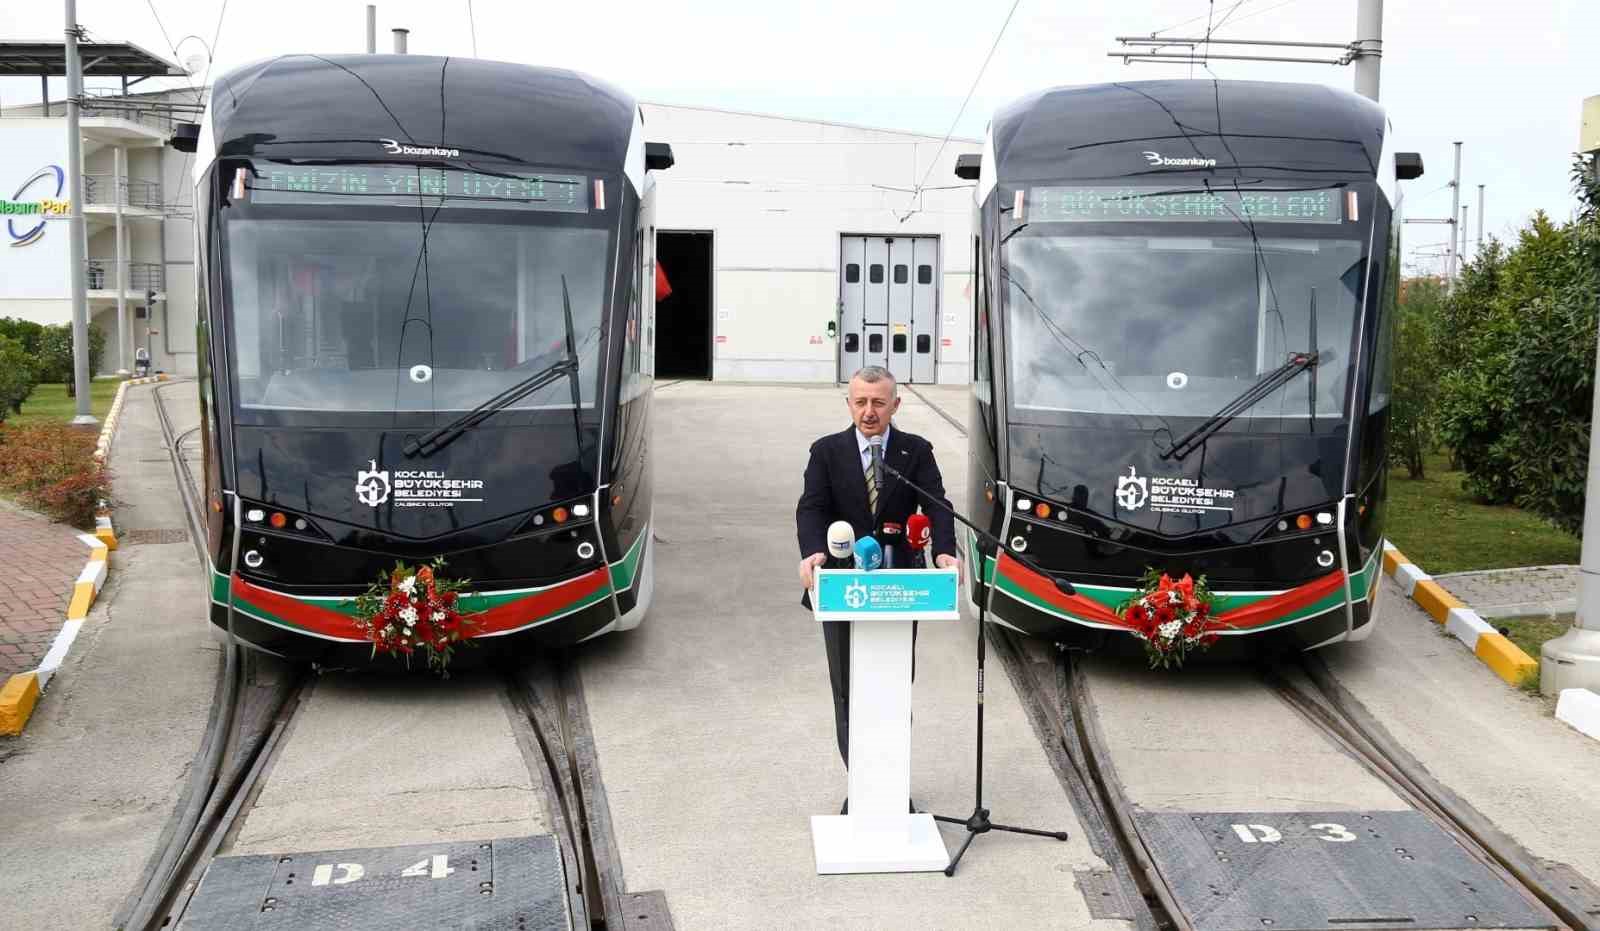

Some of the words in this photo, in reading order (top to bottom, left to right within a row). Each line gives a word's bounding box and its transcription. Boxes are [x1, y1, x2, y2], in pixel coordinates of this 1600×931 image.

[403, 145, 460, 158] bozankaya
[1164, 156, 1217, 168] bozankaya
[394, 479, 484, 489] BÜYÜKŞEHİR
[1151, 485, 1235, 499] BÜYÜKŞEHİR
[1231, 823, 1282, 844] D
[1309, 823, 1357, 843] 3
[311, 863, 366, 887] D
[401, 854, 457, 880] 4
